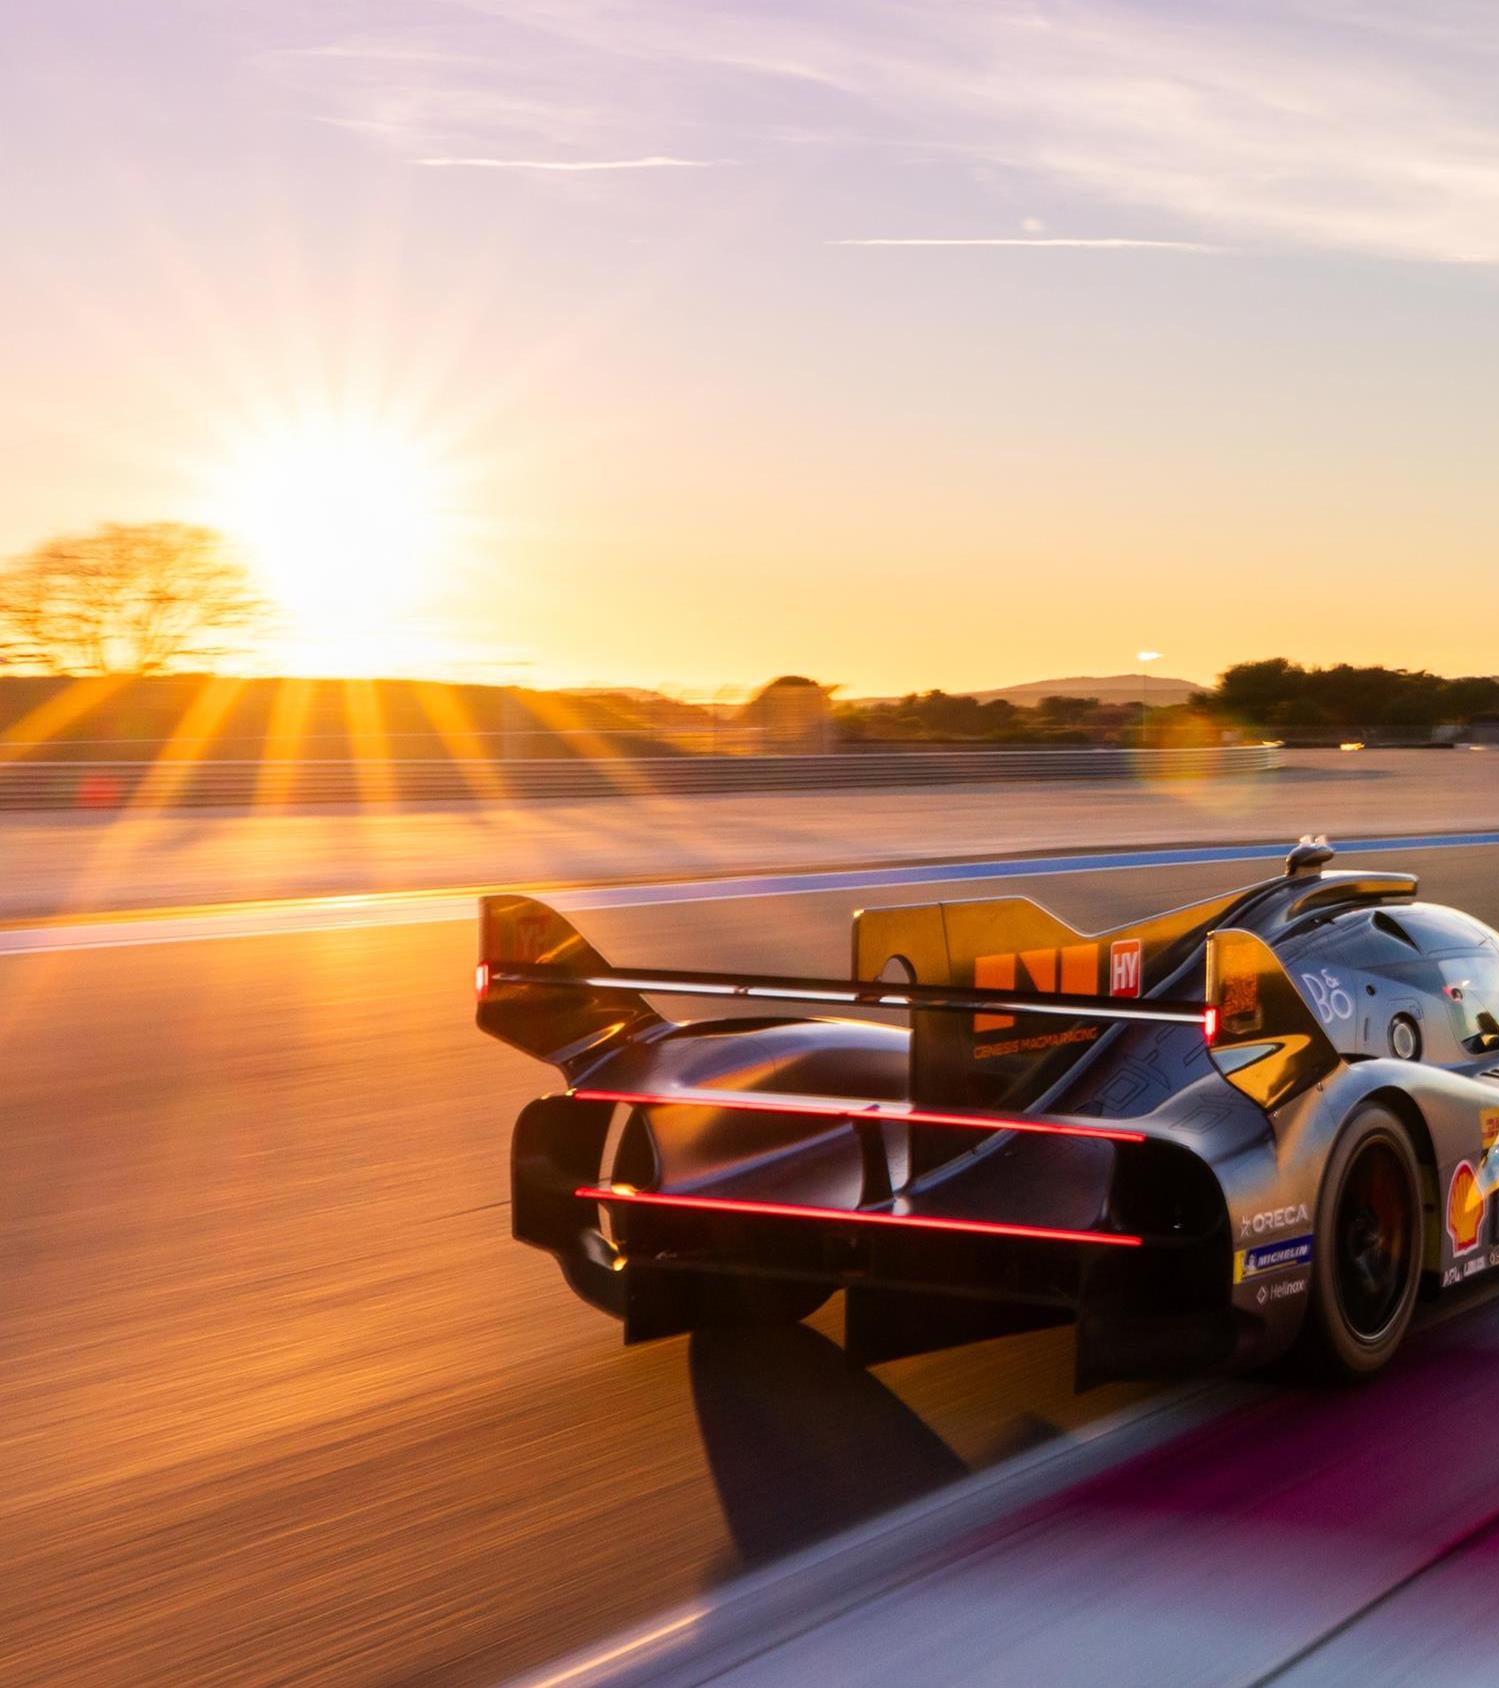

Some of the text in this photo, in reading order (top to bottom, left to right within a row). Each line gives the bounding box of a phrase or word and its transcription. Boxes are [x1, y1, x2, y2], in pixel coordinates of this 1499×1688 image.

[1112, 951, 1139, 990] HY
[974, 1040, 1019, 1060] GENESIS
[1061, 1026, 1099, 1047] RACING
[1252, 1203, 1309, 1233] ORECA
[1257, 1244, 1308, 1268] MICHELIN
[1269, 1279, 1305, 1300] Helinox
